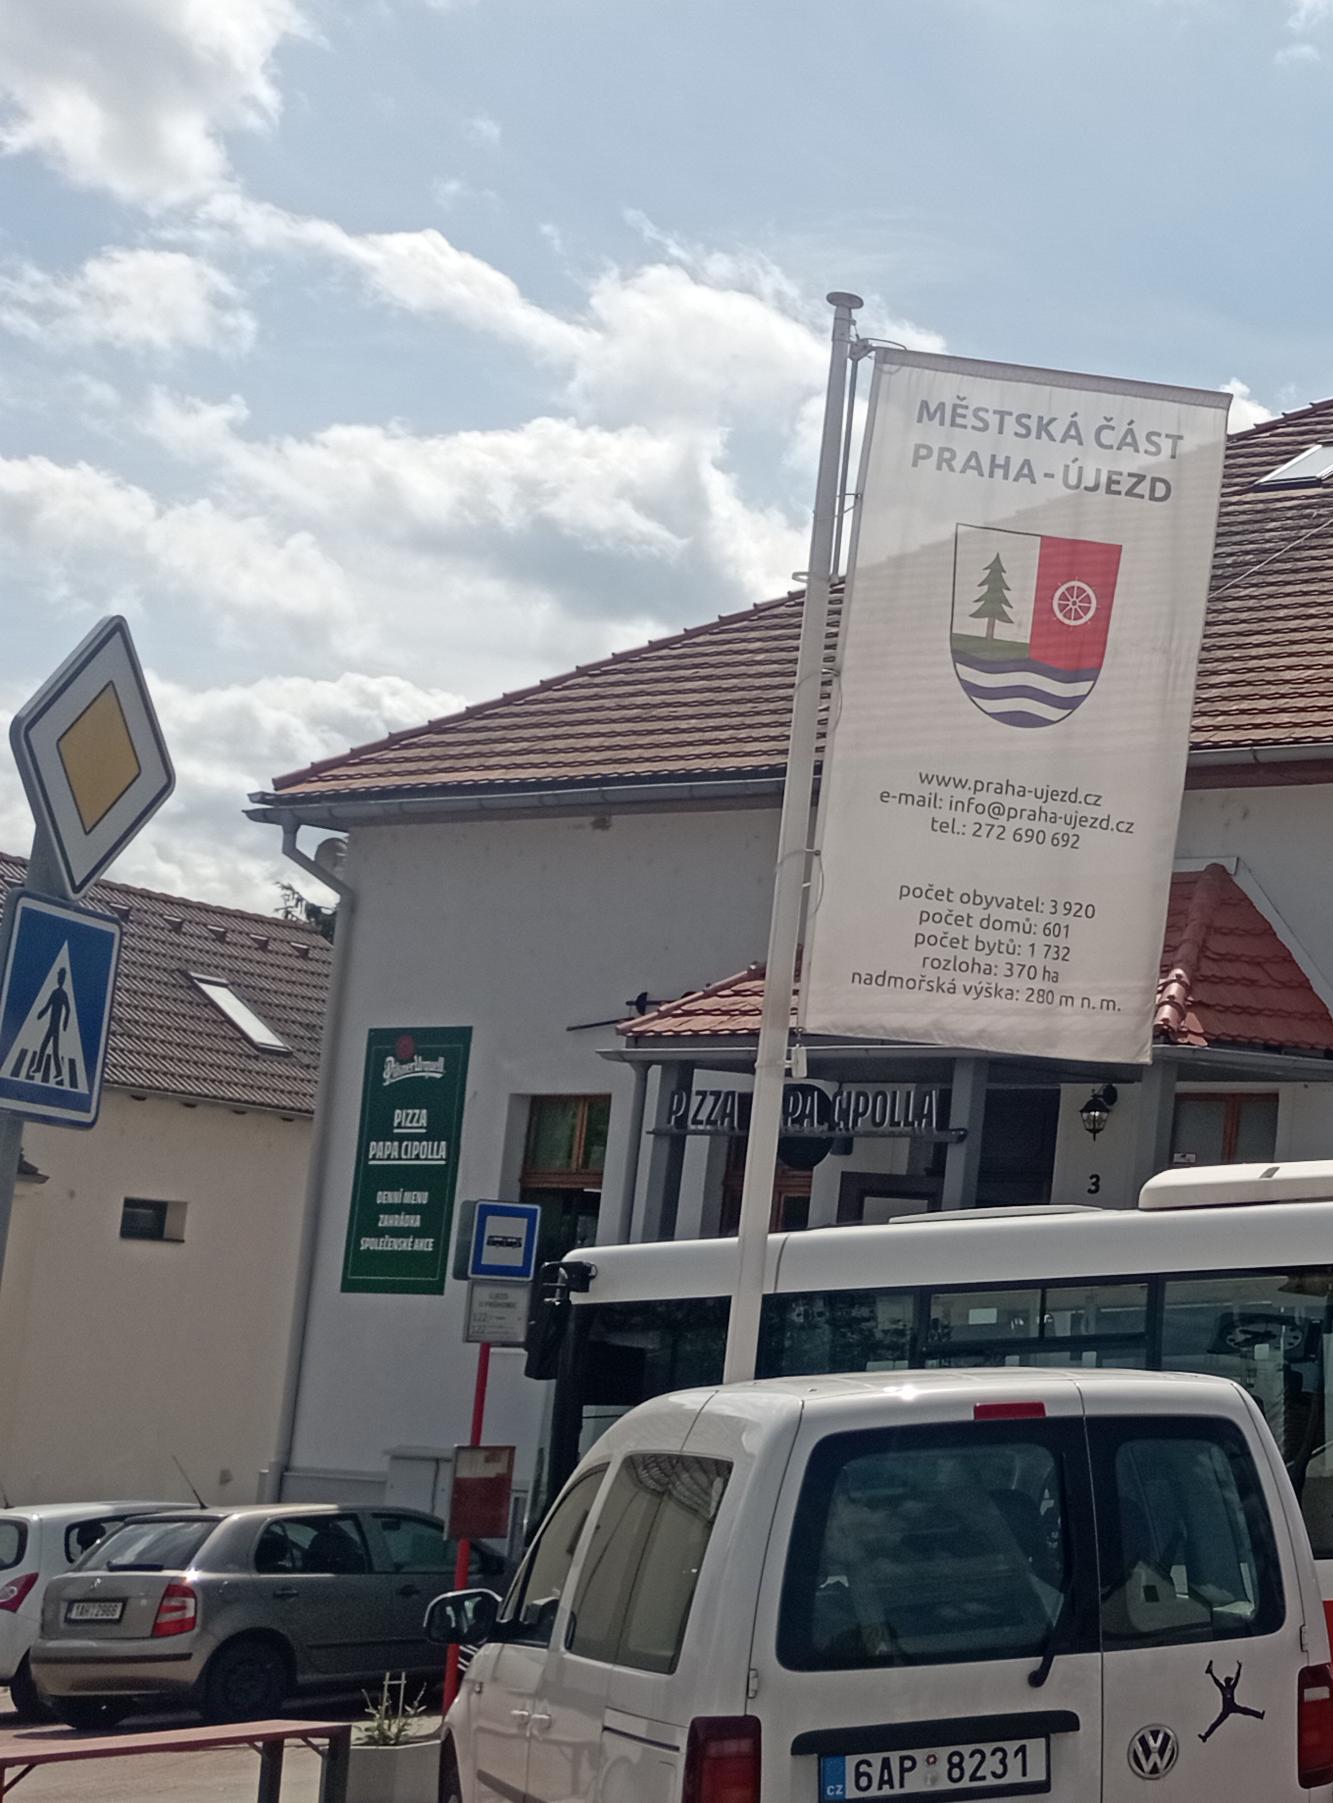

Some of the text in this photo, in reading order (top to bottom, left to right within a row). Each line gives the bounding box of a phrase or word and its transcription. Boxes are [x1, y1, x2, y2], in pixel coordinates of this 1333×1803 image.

[916, 395, 1184, 459] MĚSTSKÁ ČÁST
[918, 772, 1102, 807] www.praha-ujezd.cz
[880, 790, 1135, 834] e-mail: info@praha-ujezd.cz
[930, 816, 1081, 849] tel.: 272 690 692
[899, 883, 954, 903] počet
[959, 889, 1045, 914] obyvatel:
[919, 909, 1070, 939] počet domů: 601
[914, 931, 969, 951] počet
[975, 935, 1022, 957] bytů:
[1043, 944, 1071, 962] 732
[922, 955, 1060, 984] rozloha: 370 ha
[851, 970, 1122, 1012] nadmořská výška: 280 m n. m.
[393, 1109, 428, 1128] PIZZA
[368, 1140, 447, 1160] PAPA CIPOLLA
[376, 1188, 429, 1204] DENNÍ MENU
[1087, 1174, 1101, 1195] 3
[378, 1211, 421, 1228] ZAHRÁDKA
[853, 1743, 1028, 1794] 6AP 8231
[826, 1784, 844, 1796] CZ
